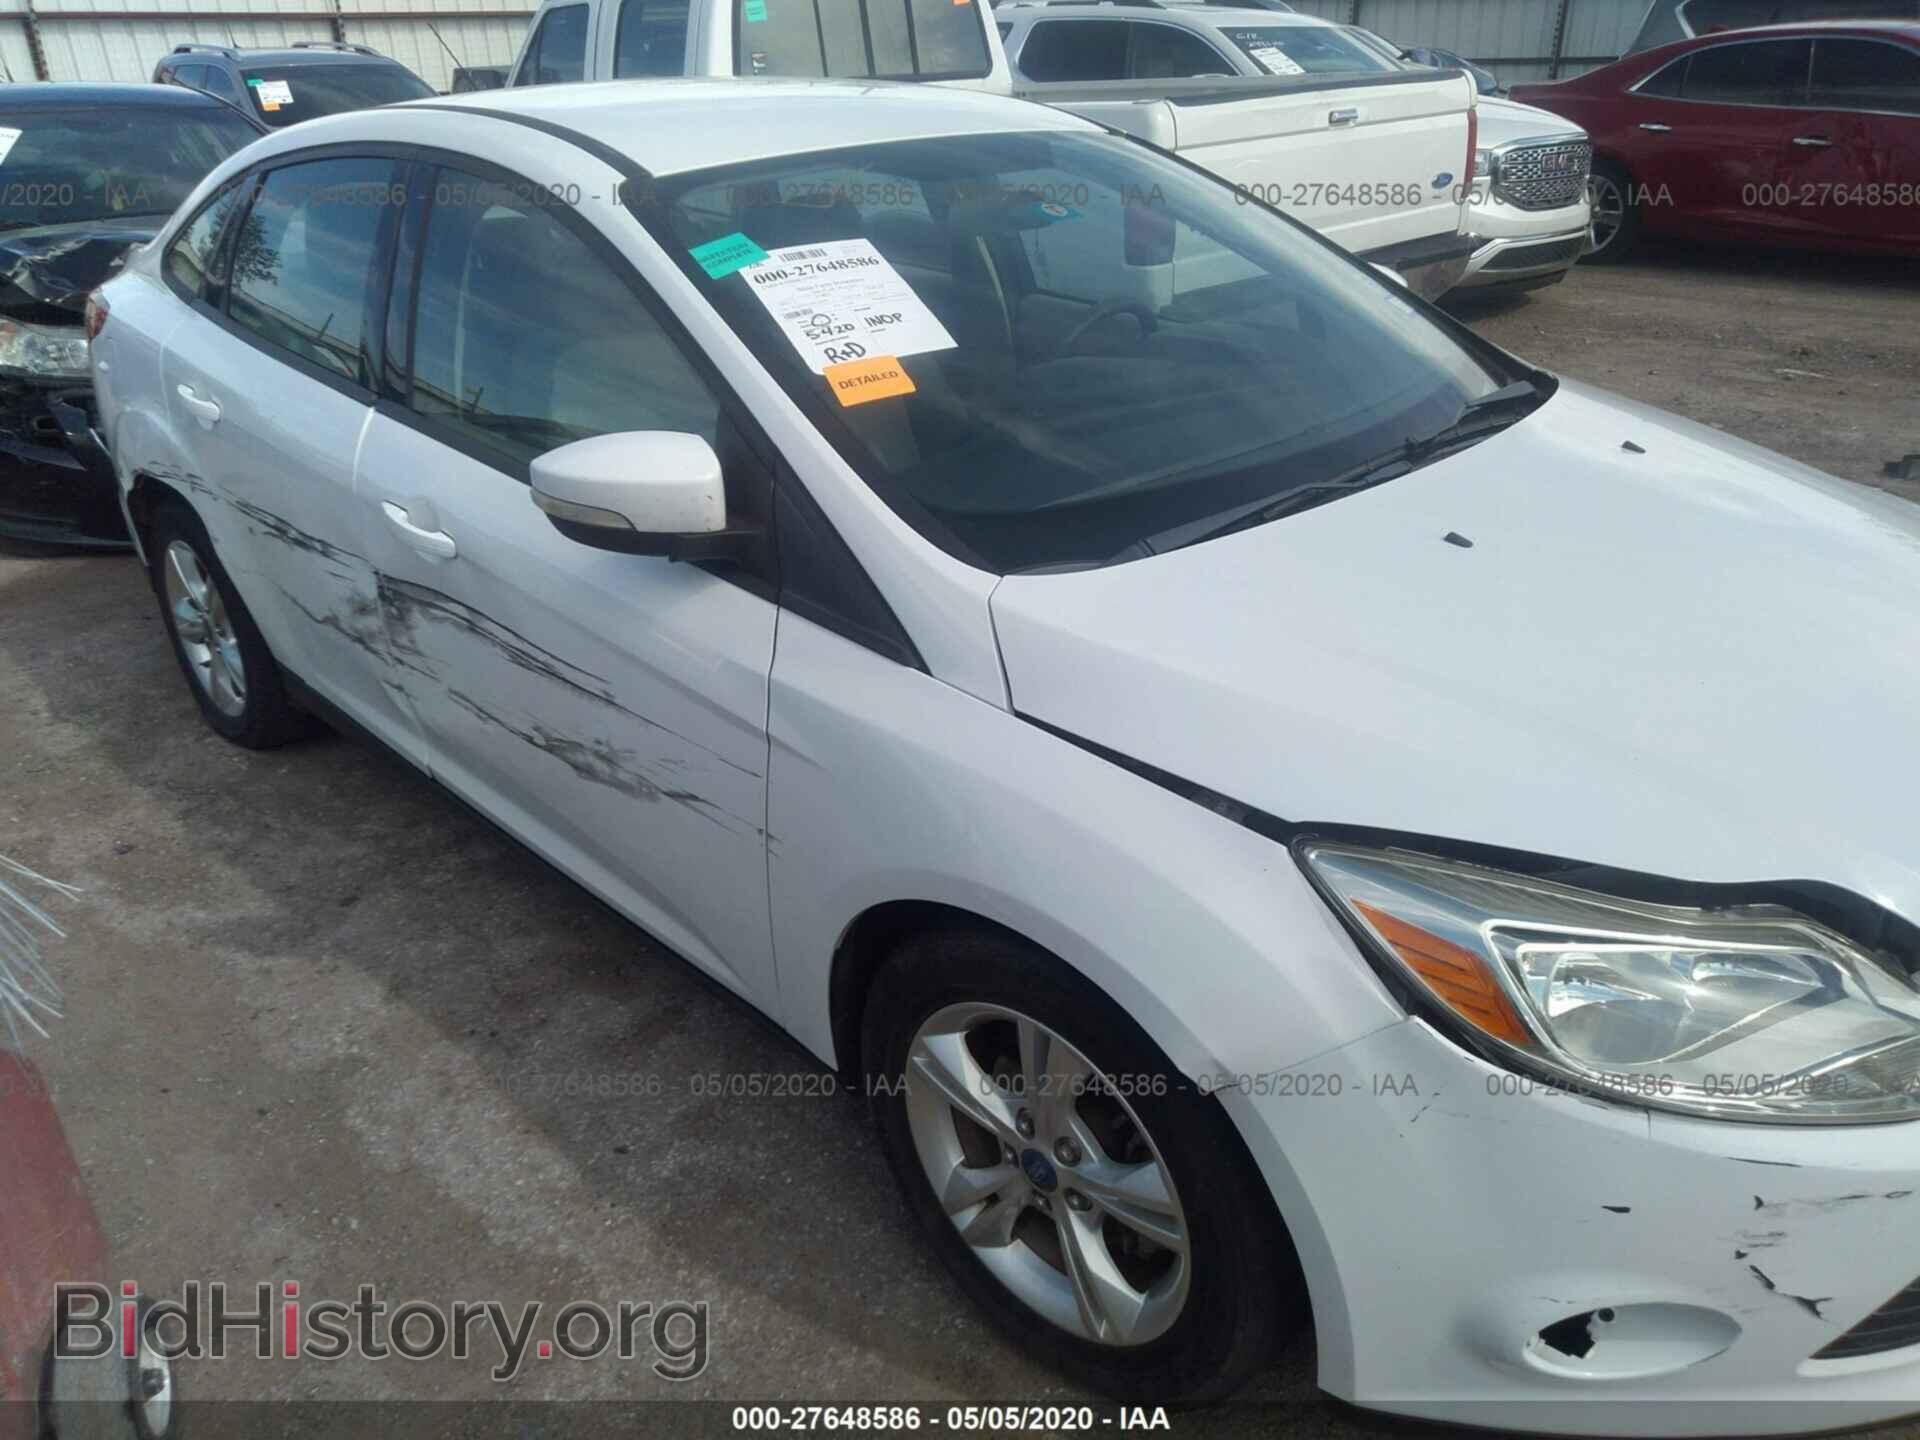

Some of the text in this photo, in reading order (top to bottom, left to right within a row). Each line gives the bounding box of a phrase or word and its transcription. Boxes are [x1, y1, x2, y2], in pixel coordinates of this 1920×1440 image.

[753, 255, 880, 286] 000-27648586
[863, 312, 903, 328] INOP
[838, 370, 899, 390] DETAILED
